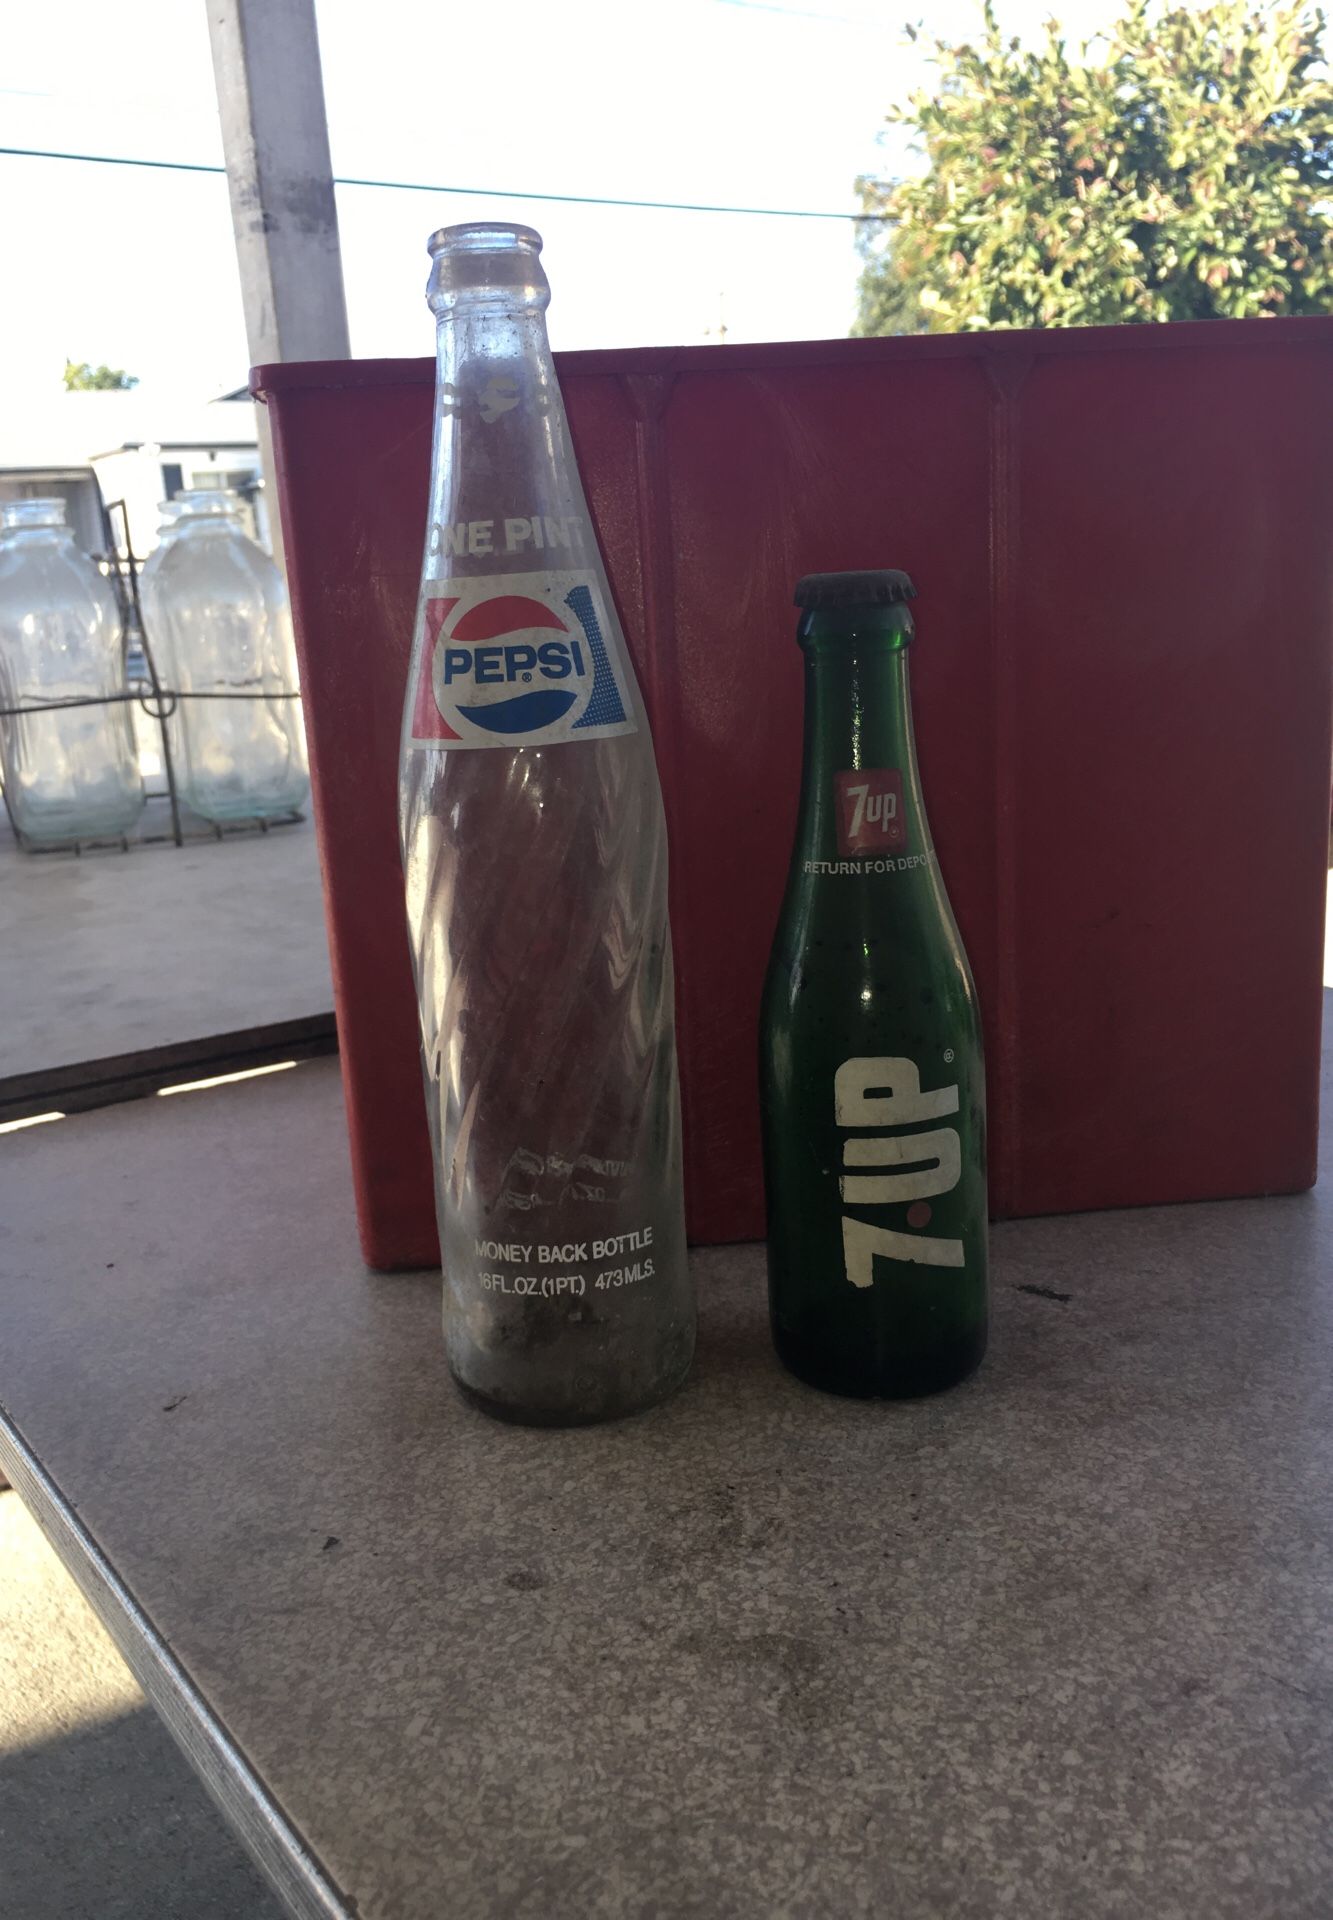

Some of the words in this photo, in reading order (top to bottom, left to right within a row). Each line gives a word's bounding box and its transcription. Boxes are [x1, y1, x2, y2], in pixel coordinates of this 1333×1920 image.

[430, 520, 494, 557] ONE
[504, 516, 585, 551] PINT
[444, 632, 586, 685] PEPSI
[804, 861, 861, 875] RETURN
[865, 859, 895, 874] FOR
[475, 1239, 533, 1263] MONEY
[538, 1243, 588, 1263] BACK
[592, 1227, 653, 1259] BOTTLE
